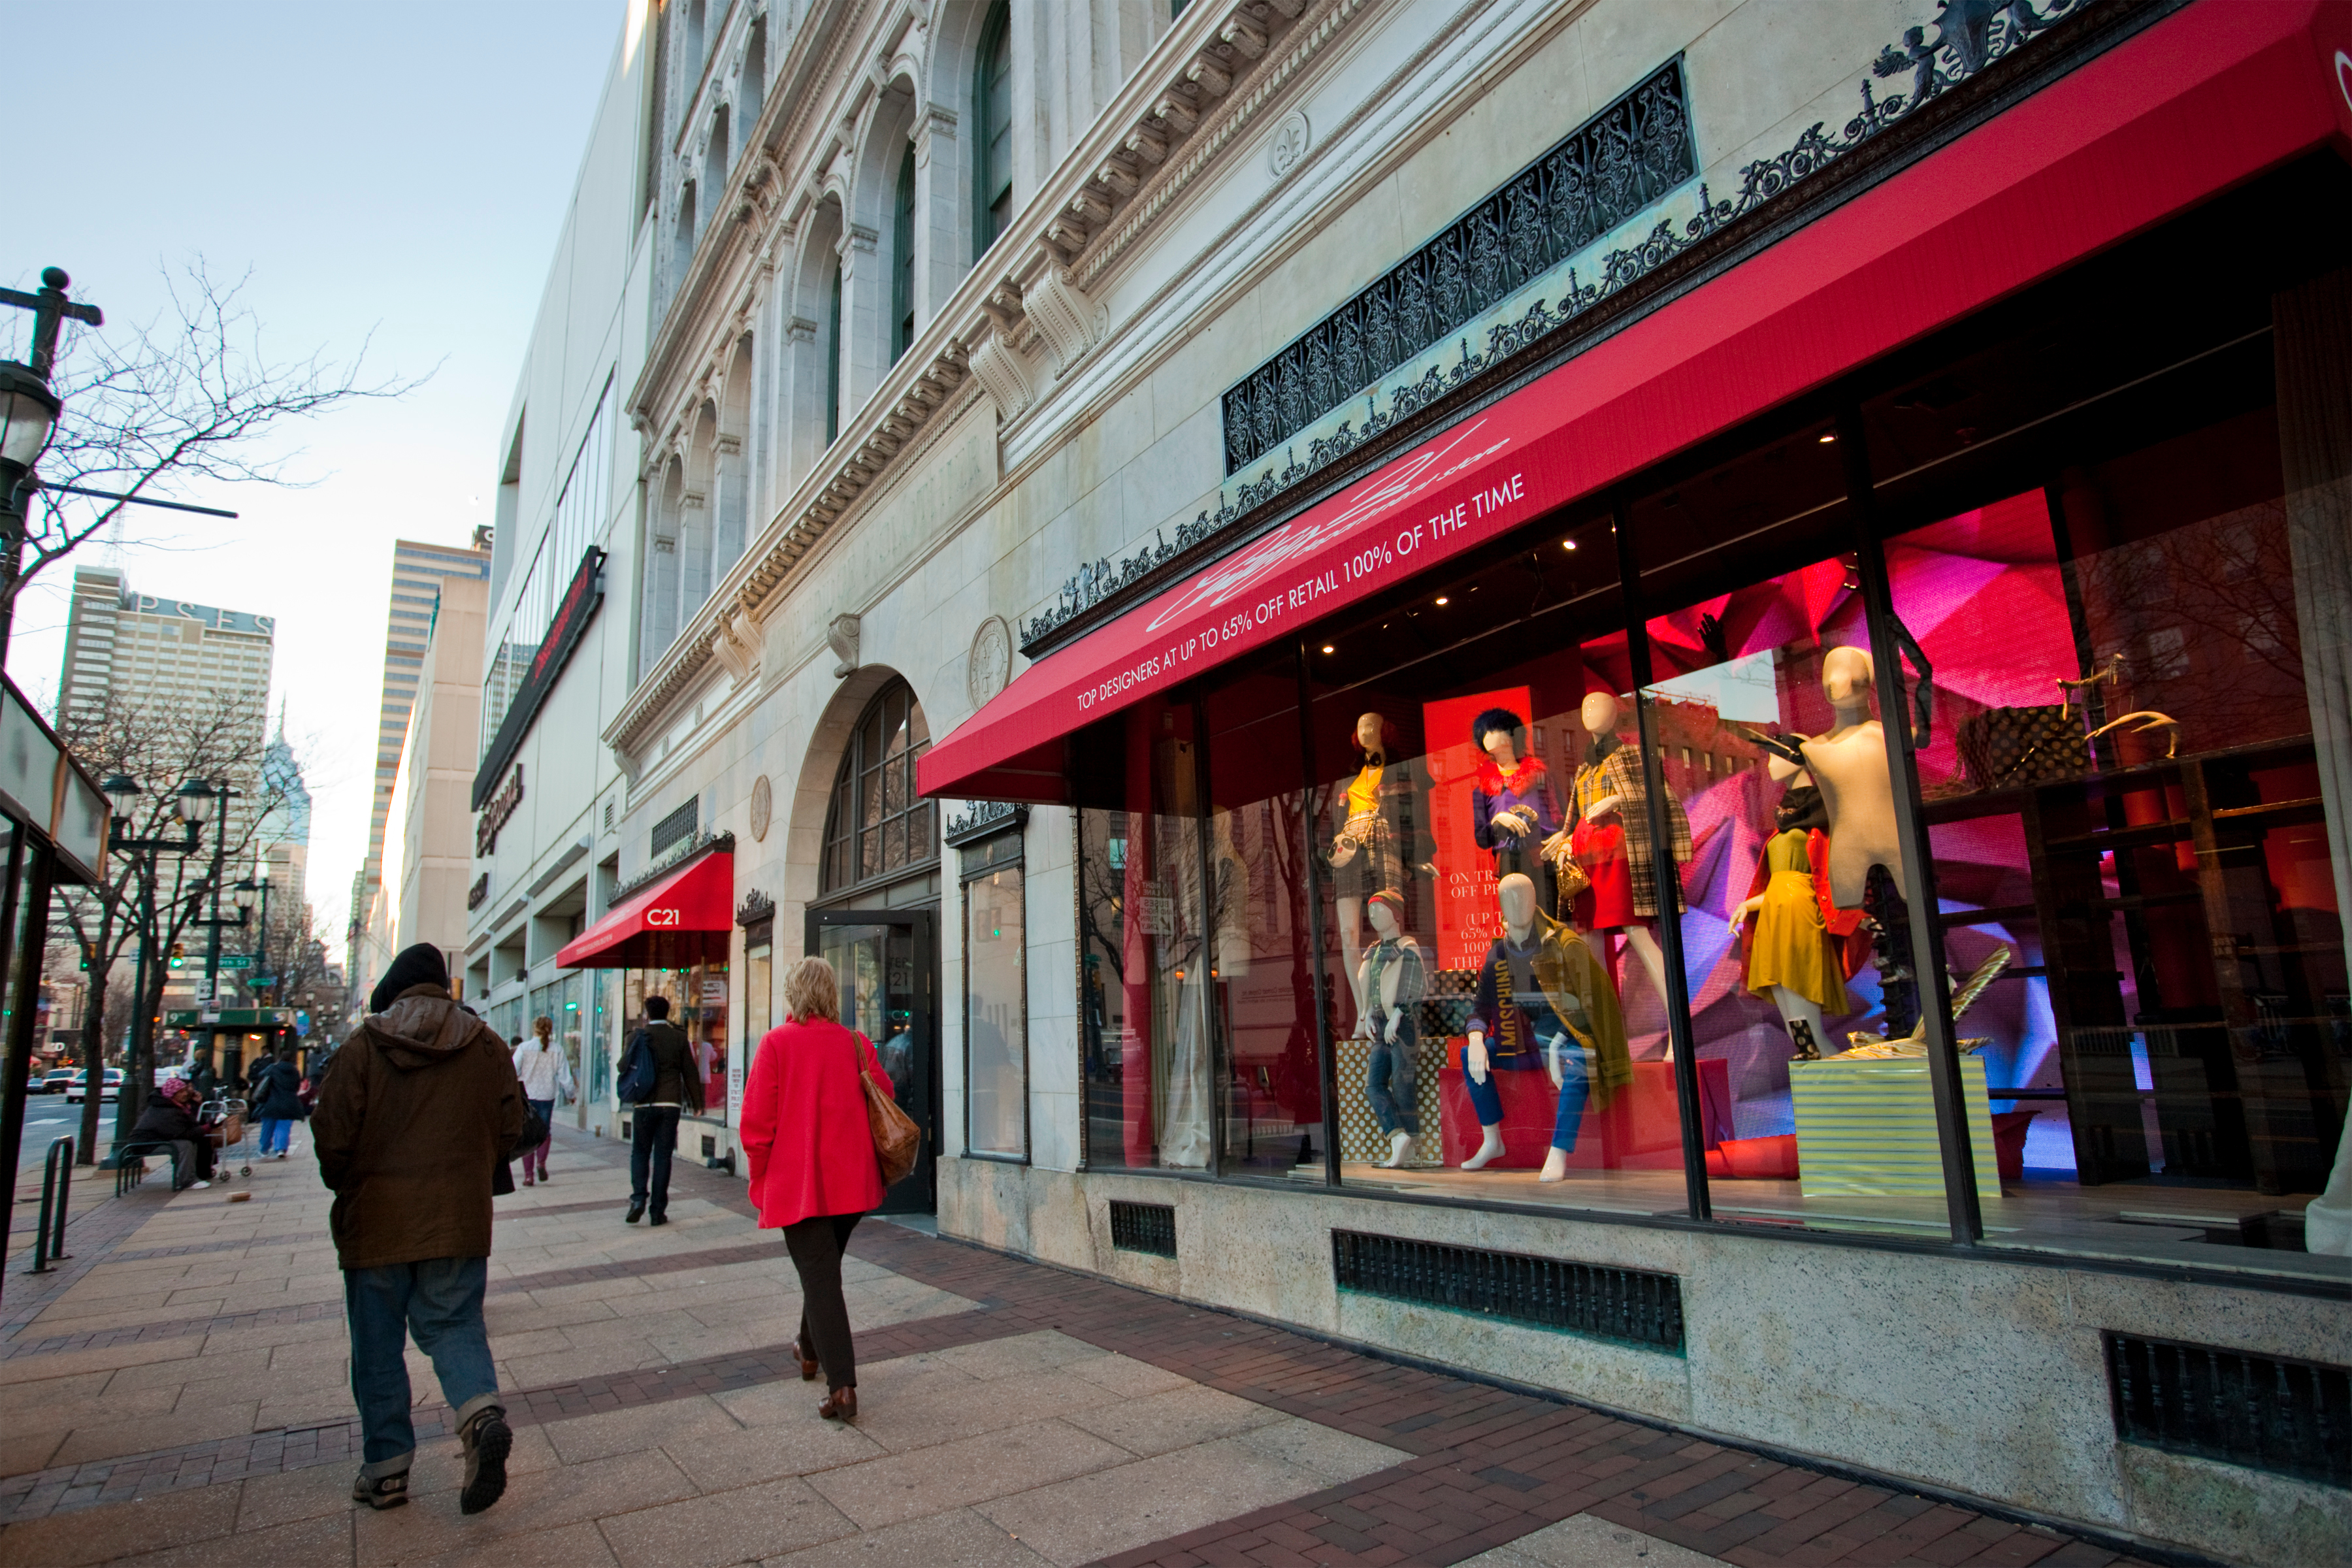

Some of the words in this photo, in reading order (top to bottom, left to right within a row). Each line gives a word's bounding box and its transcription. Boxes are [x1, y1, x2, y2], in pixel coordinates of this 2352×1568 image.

[1077, 688, 1098, 711] TOP
[1100, 657, 1160, 701] DESIGNERS
[1163, 647, 1177, 670] AT
[1181, 638, 1197, 661] UP
[1199, 628, 1218, 651] TO
[1222, 610, 1252, 641] 65%
[1256, 595, 1284, 624] OFF
[1288, 570, 1339, 610] RETAIL
[1343, 541, 1392, 582] 100%
[1397, 524, 1424, 555] OF
[1428, 502, 1468, 540] THE
[1471, 473, 1525, 518] TIME
[1450, 872, 1469, 885] ON
[1475, 870, 1499, 882] TR
[1451, 885, 1478, 898] OFF
[647, 909, 679, 926] C21
[1461, 926, 1488, 940] 65%
[1451, 955, 1482, 969] THE
